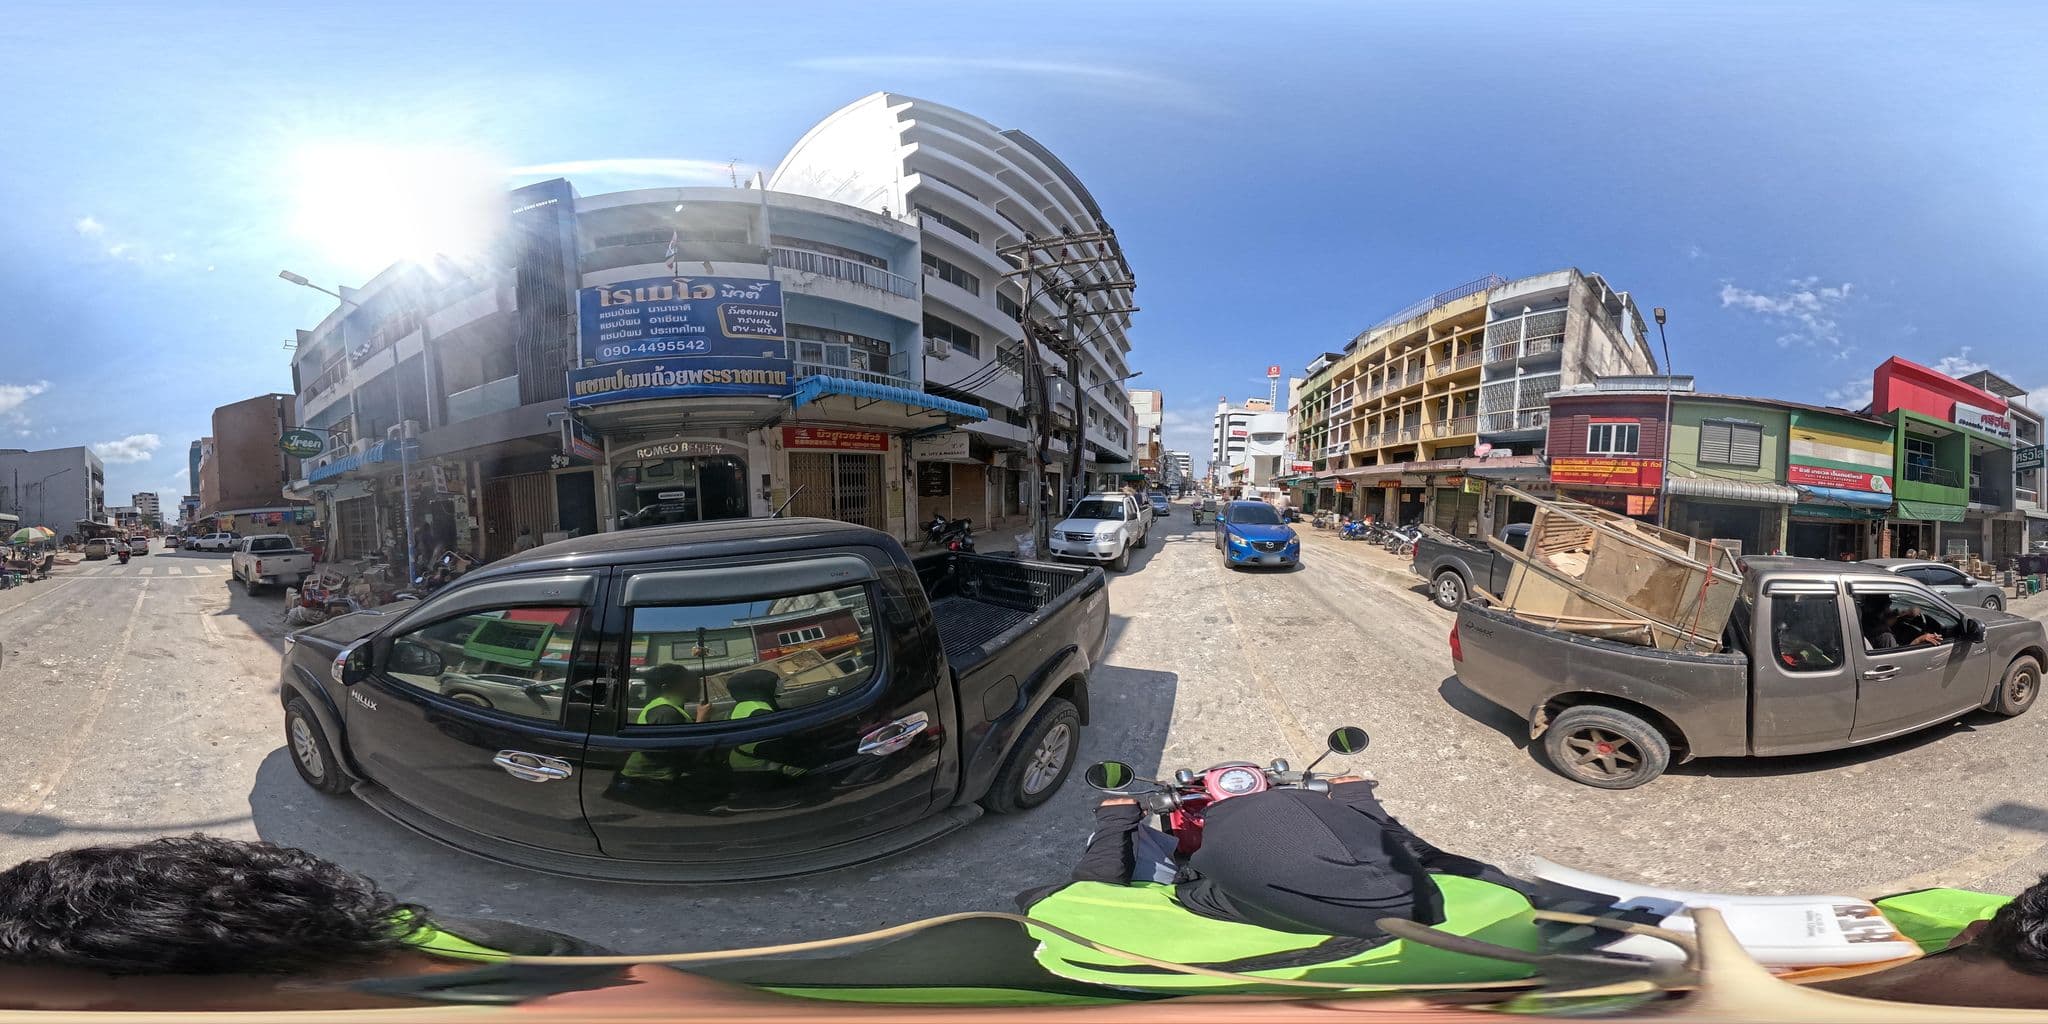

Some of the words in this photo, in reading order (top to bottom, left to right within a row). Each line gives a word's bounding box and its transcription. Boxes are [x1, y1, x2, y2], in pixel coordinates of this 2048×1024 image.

[596, 279, 716, 306] โรเมโอ
[721, 282, 770, 300] บิวตี้
[648, 303, 692, 313] นานาชาติ
[649, 314, 688, 324] อาเซียน
[650, 324, 706, 336] ประเทศไทย
[603, 340, 705, 357] 090-4495542
[636, 443, 679, 459] ROMEO
[351, 689, 377, 711] HILUX
